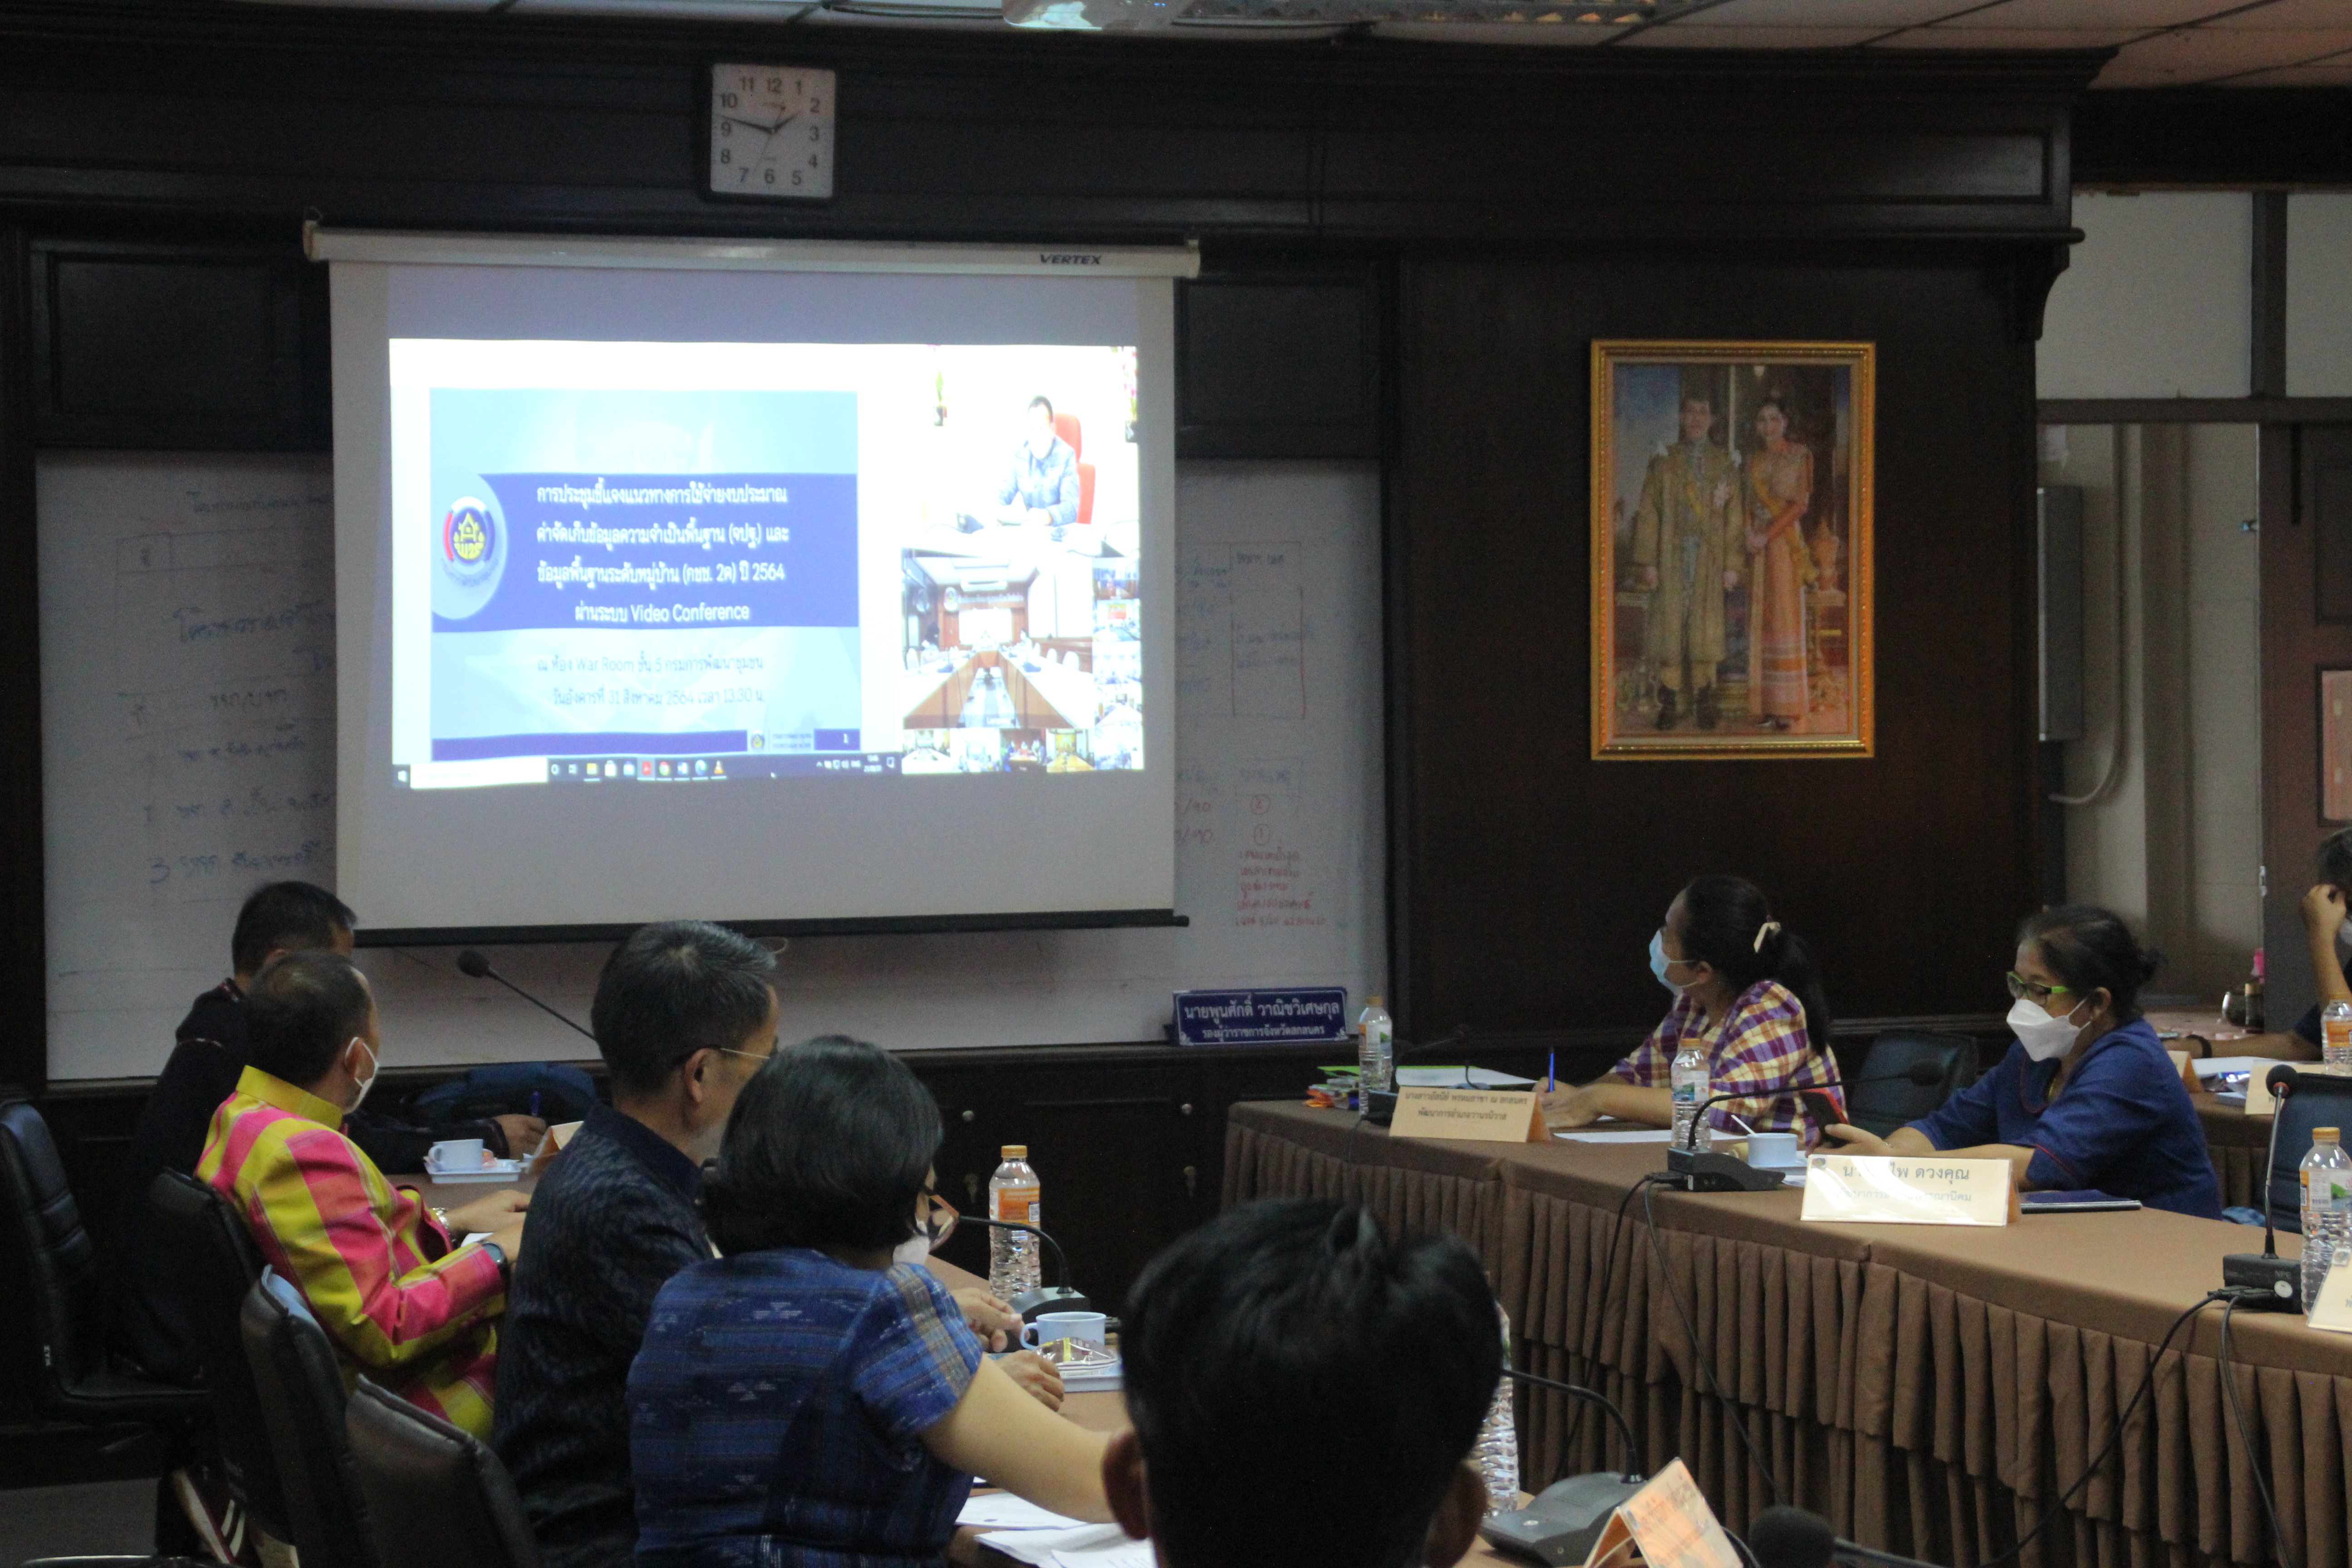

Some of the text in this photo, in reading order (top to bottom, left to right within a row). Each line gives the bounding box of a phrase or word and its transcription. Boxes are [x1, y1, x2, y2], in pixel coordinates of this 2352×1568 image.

[740, 77, 754, 91] 11
[767, 78, 782, 93] 12
[796, 79, 802, 94] 1
[720, 93, 738, 108] 10
[810, 97, 820, 113] 2
[720, 121, 731, 137] 9
[810, 125, 819, 141] 3
[720, 149, 730, 164] 8
[808, 154, 818, 168] 4
[739, 167, 749, 181] 7
[764, 168, 775, 184] 6
[793, 170, 802, 185] 5
[1039, 254, 1102, 264] VERTEX
[766, 526, 789, 542] และ
[739, 560, 749, 581] ปี
[752, 562, 785, 581] 2564
[575, 599, 750, 622] ผ่านระบบ Video Conference
[538, 659, 548, 672] ณ
[551, 653, 572, 672] ห้อง
[575, 657, 599, 671] War
[602, 657, 634, 671] Room
[638, 650, 651, 672] ชั้น
[655, 657, 662, 672] 5
[608, 689, 620, 705] 31
[666, 690, 694, 705] 2564
[698, 691, 719, 704] เวลา
[843, 733, 849, 745] 1
[1915, 1167, 1970, 1185] ดวงคุณ
